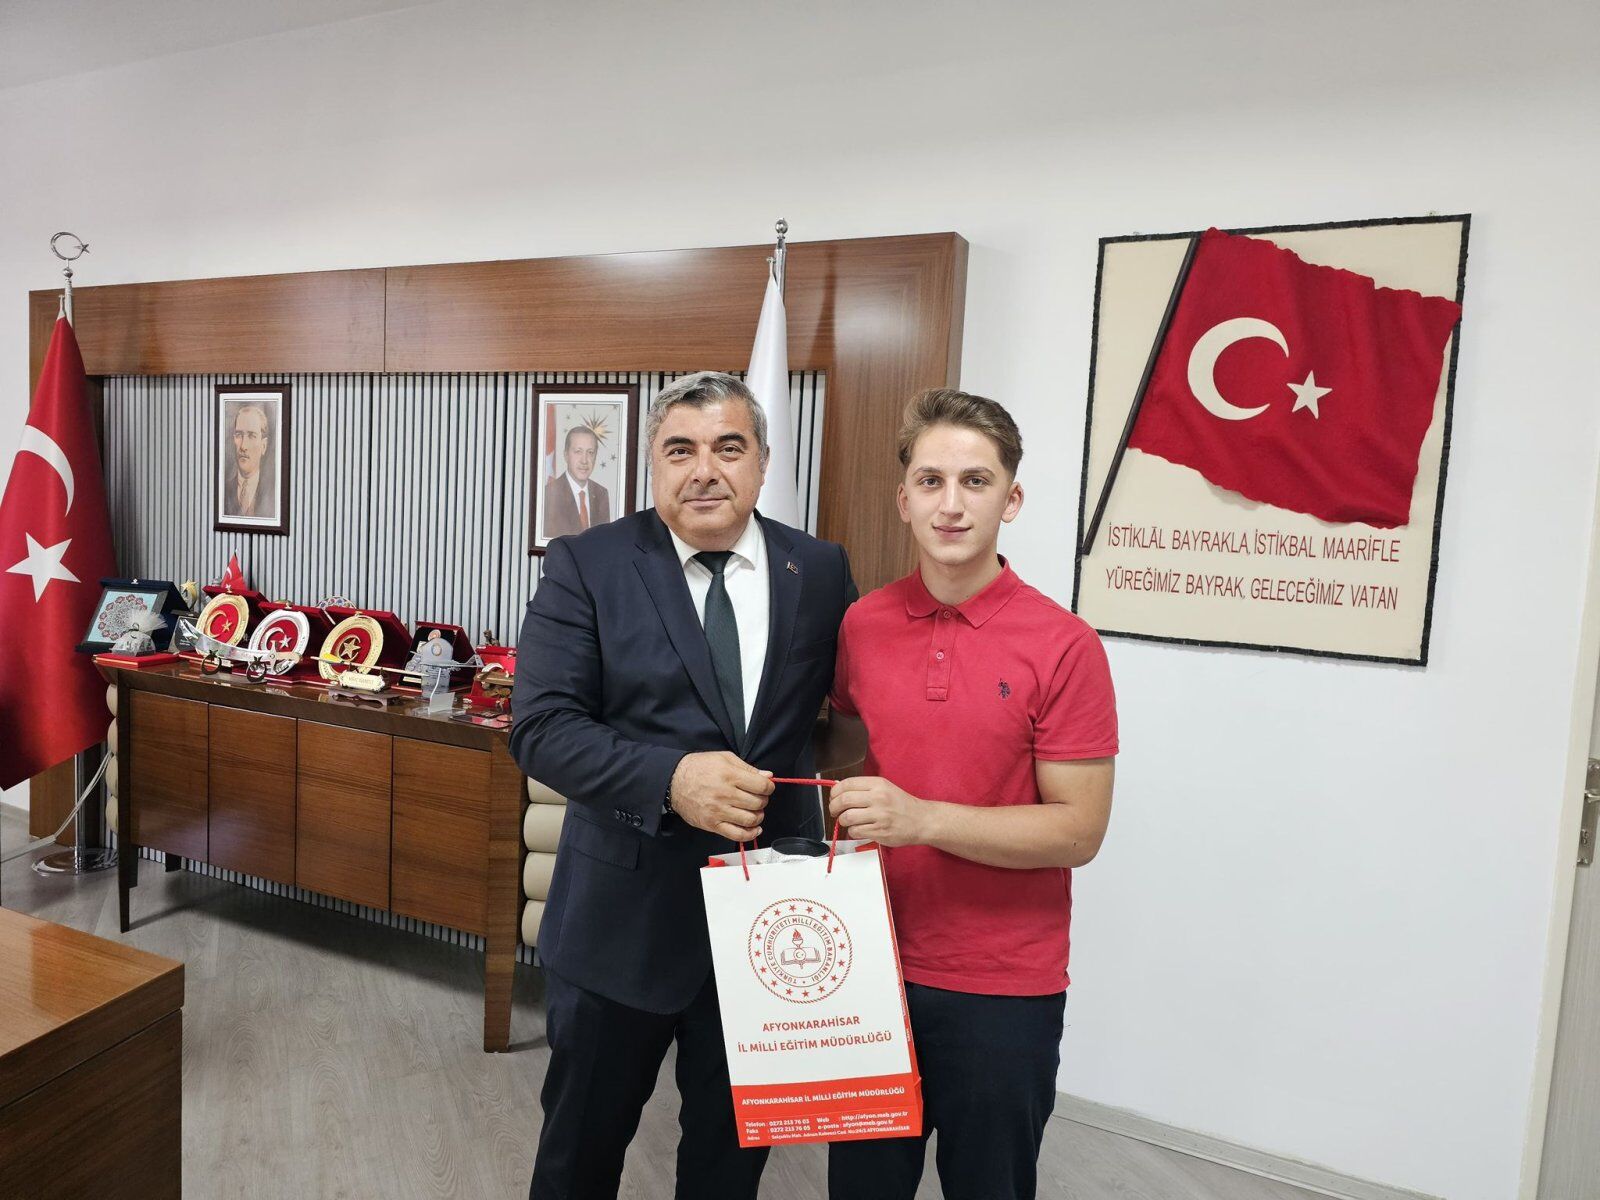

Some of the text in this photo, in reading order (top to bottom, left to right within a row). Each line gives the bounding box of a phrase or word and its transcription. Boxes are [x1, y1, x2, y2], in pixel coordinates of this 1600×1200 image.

[1172, 529, 1251, 555] BAYRAKLA,
[1254, 529, 1316, 558] İSTİKBAL
[1322, 534, 1401, 562] MAARİFLE
[1106, 567, 1398, 610] YÜREĞİMİZ BAYRAK, GELECEĞİMİZ VATAN
[766, 918, 791, 961] CUMHURİYETİ
[792, 917, 812, 926] MİLLİ
[813, 923, 831, 943] EĞİTİM
[762, 1015, 861, 1032] AFYONKARAHİSAR
[738, 1041, 748, 1053] İL
[749, 1039, 778, 1053] MİLLİ
[779, 1037, 818, 1052] EĞİTİM
[820, 1031, 892, 1049] MÜDÜRLÜĞÜ
[742, 1086, 905, 1106] AFYONKARAHİSAR İL MİLLİ EĞİTİM MÜDÜRLÜĞÜ
